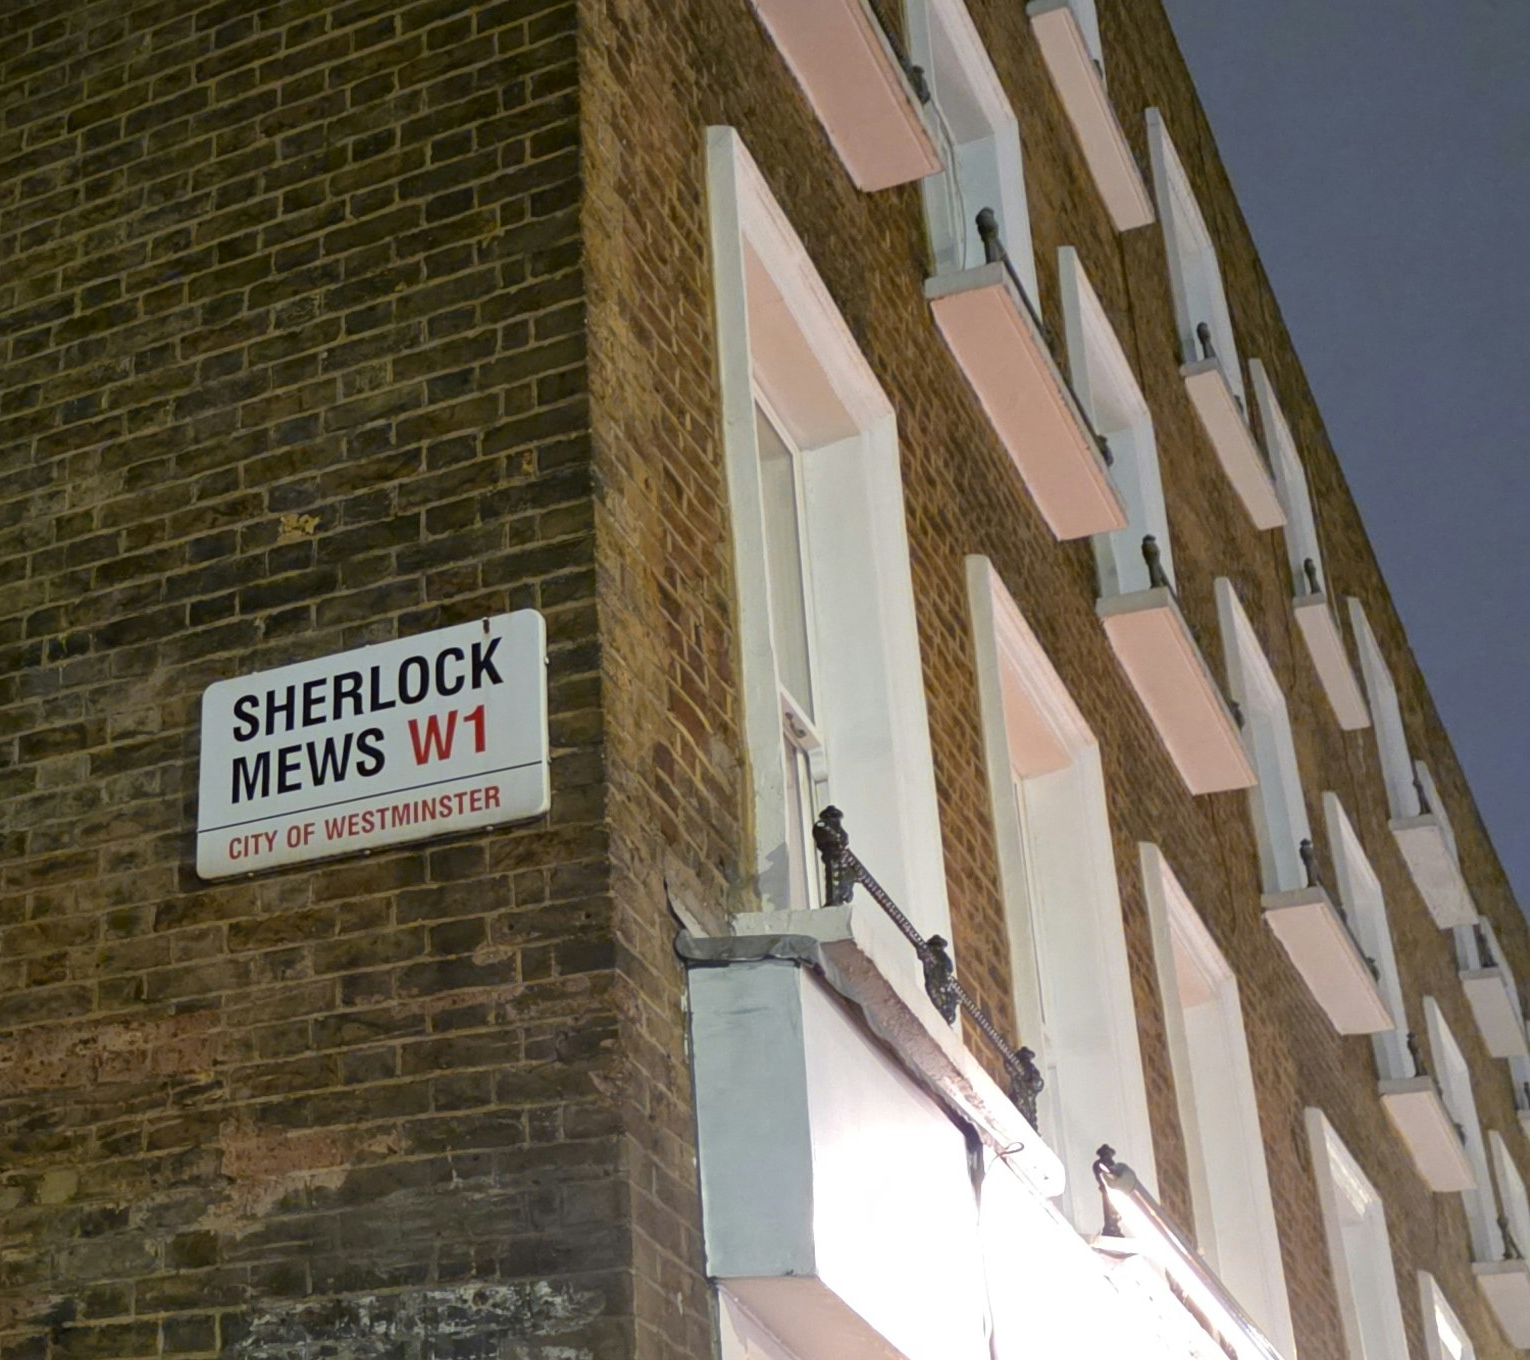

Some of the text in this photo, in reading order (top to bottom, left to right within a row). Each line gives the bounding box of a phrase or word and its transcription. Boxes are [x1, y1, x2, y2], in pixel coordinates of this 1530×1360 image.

[233, 636, 504, 742] SHERLOCK
[231, 704, 486, 804] MEWS W1
[228, 785, 501, 860] CITY OF WESTMINSTER
